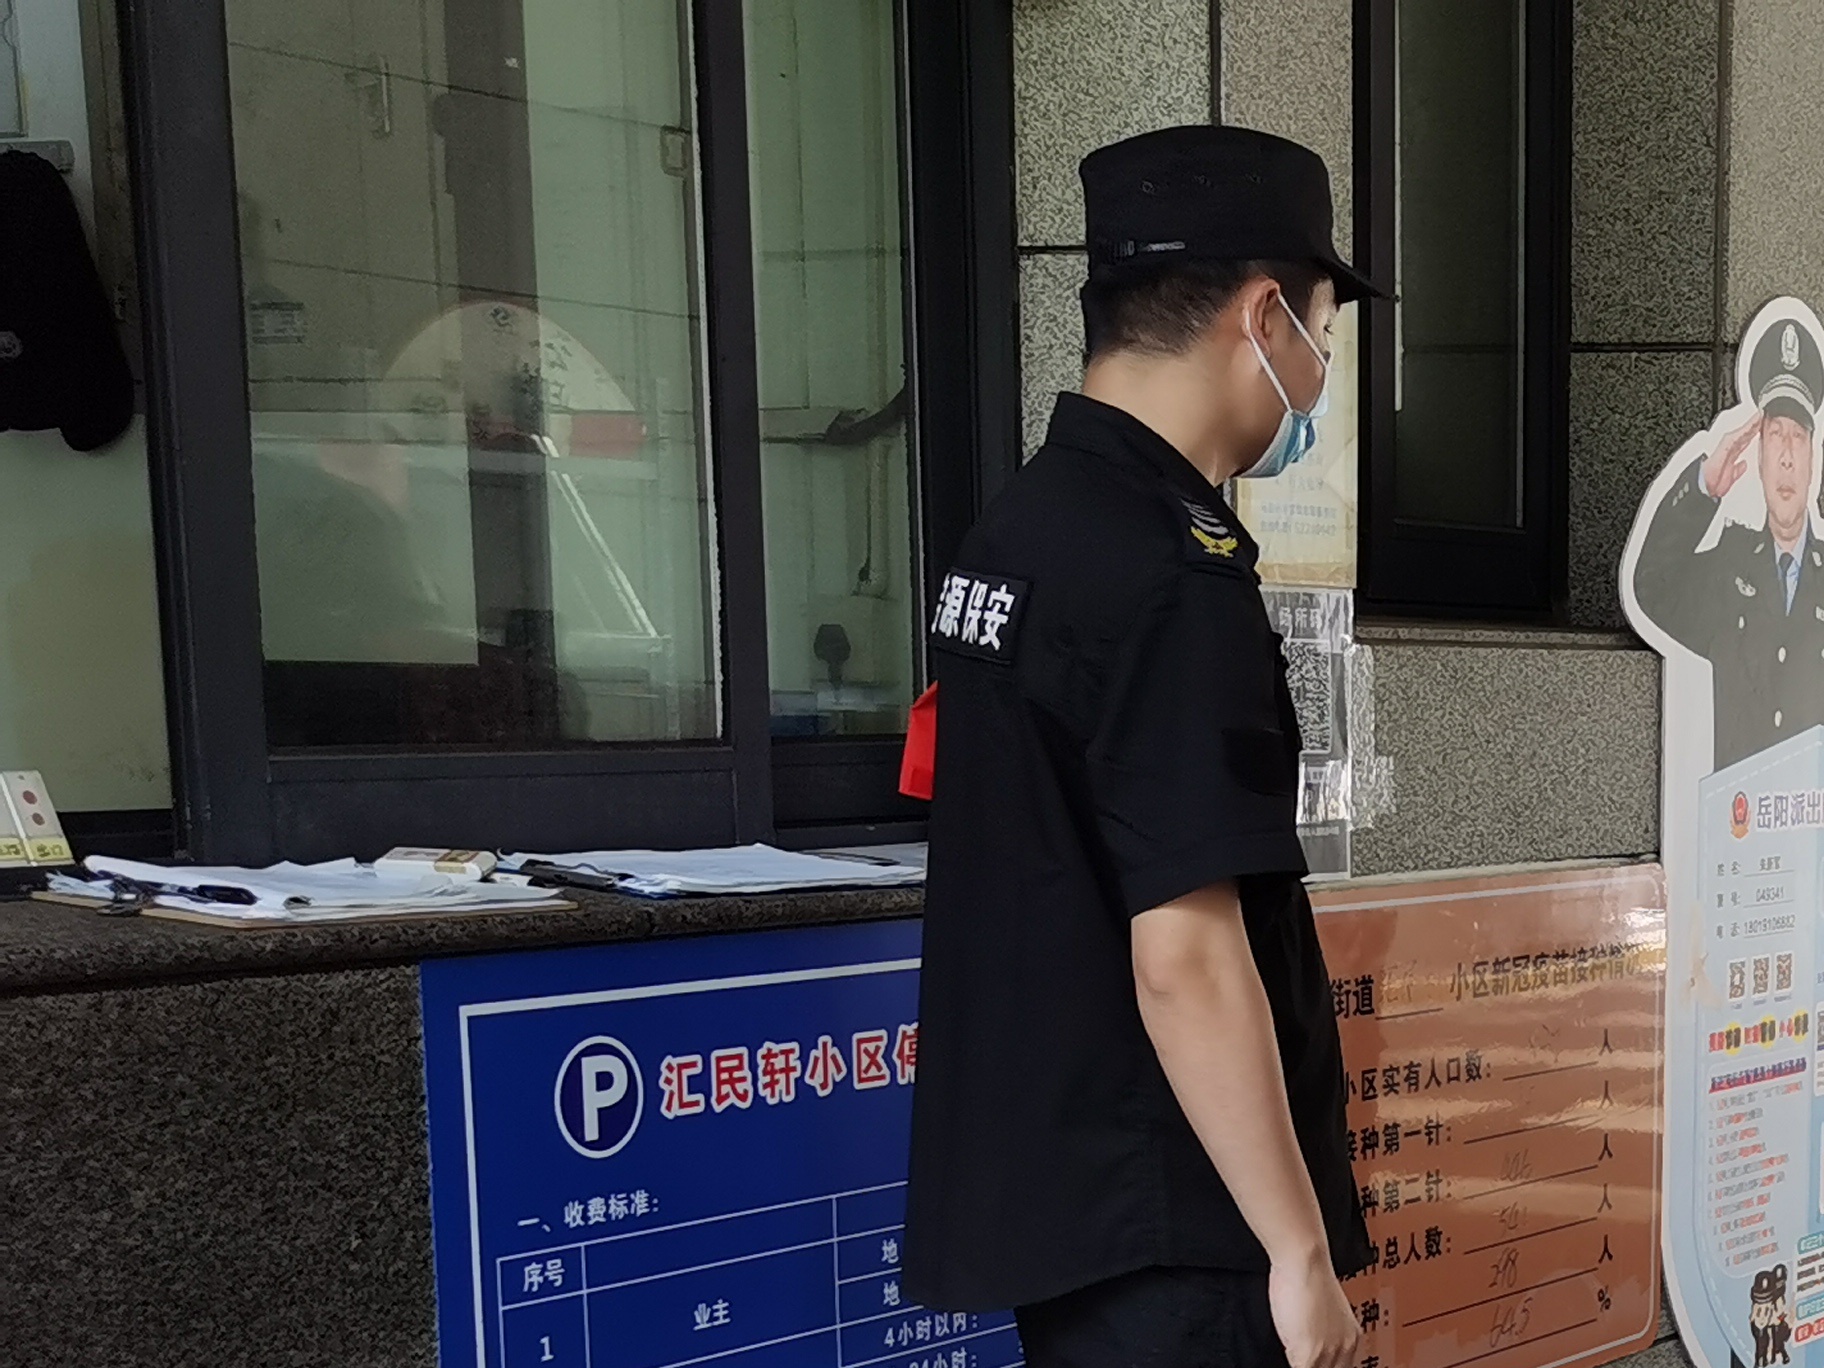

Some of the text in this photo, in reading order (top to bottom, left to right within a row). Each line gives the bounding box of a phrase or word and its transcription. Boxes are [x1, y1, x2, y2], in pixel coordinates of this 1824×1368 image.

[1598, 1028, 1614, 1056] 人
[581, 1054, 628, 1142] P
[1598, 1133, 1614, 1161] 人
[1597, 1183, 1613, 1213] 人
[1598, 1234, 1614, 1263] 人
[523, 1262, 565, 1293] 序号
[693, 1300, 731, 1332] 业主
[540, 1337, 554, 1363] 1
